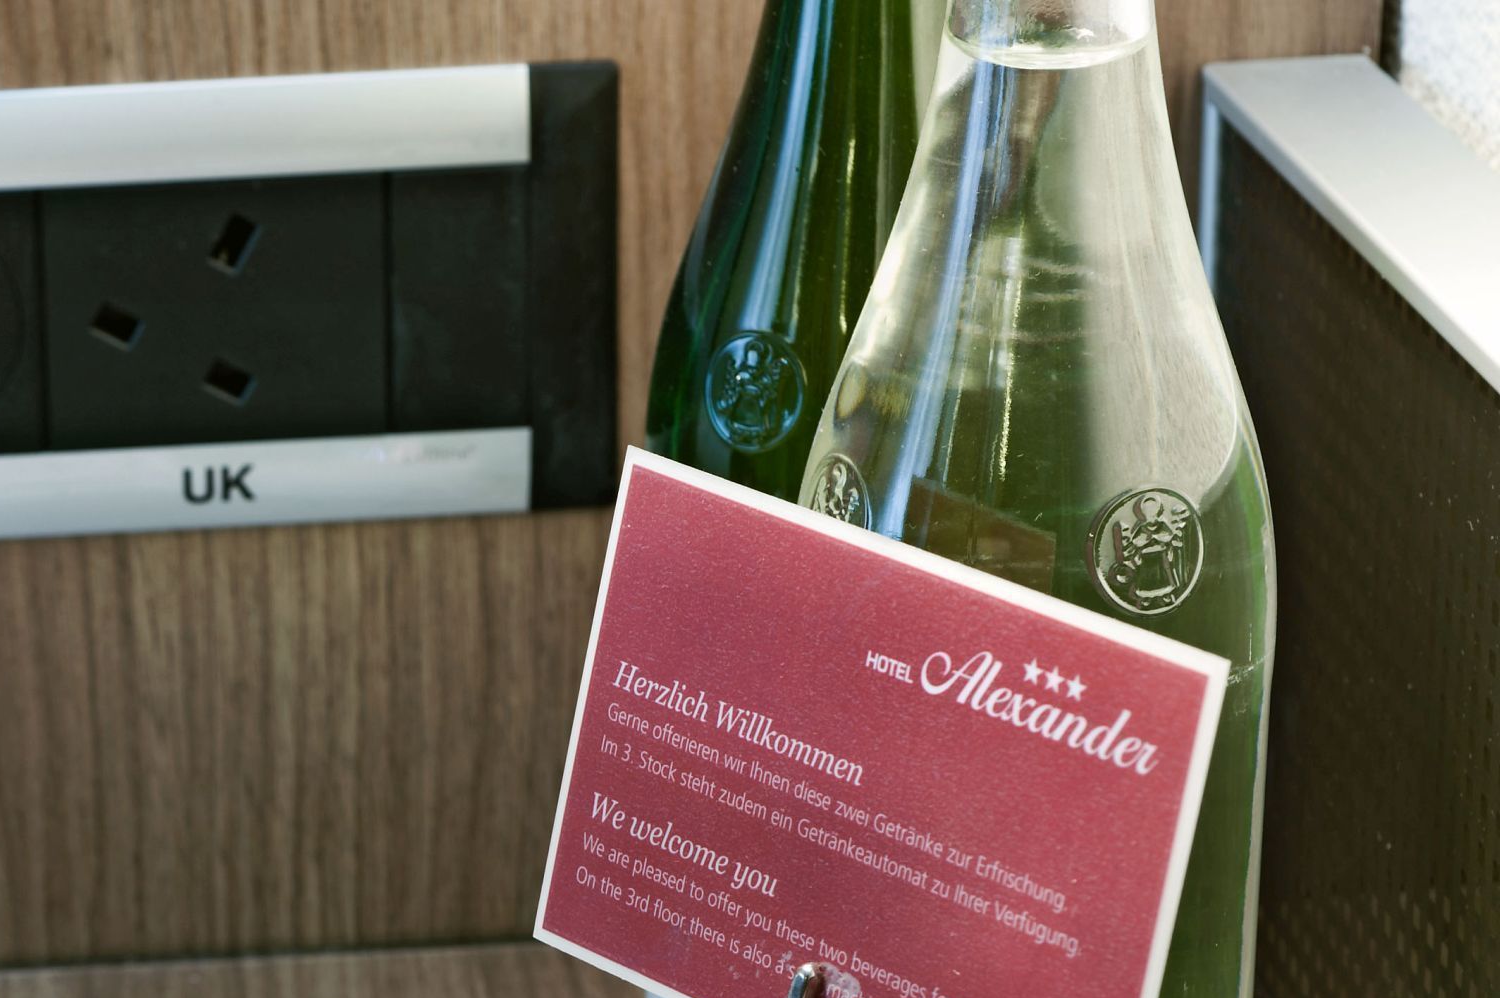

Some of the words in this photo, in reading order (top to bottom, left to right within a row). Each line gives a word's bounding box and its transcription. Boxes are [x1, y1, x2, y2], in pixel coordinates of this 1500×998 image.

[182, 464, 255, 506] UK
[611, 660, 709, 723] Herzlich
[715, 699, 864, 787] Willkommen
[864, 649, 914, 685] HOTEL
[919, 650, 1159, 777] Alexander
[591, 791, 626, 831] We
[629, 816, 730, 876] welcome
[729, 861, 778, 898] you
[600, 733, 619, 758] Im
[620, 742, 634, 764] 3.
[638, 750, 678, 783] Stock
[679, 771, 717, 799] steht
[717, 788, 767, 821] zudem
[770, 810, 793, 832] ein
[797, 817, 929, 890] Getränkeautomat
[930, 878, 951, 899] zu
[953, 884, 991, 915] Ihrer
[994, 900, 1081, 959] Verfügung.
[607, 702, 650, 736] Gerne
[652, 722, 720, 766] offerieren
[723, 753, 748, 775] wir
[749, 760, 791, 794] Ihnen
[793, 780, 832, 811] diese
[834, 800, 871, 827] zwei
[873, 812, 944, 859] Getränke
[945, 847, 973, 870] zur
[975, 854, 1067, 914] Erfrischung.
[575, 865, 597, 890] On
[600, 876, 623, 901] the
[625, 887, 651, 913] 3rd
[653, 898, 687, 929] floor
[689, 916, 726, 948] there
[728, 937, 741, 955] is
[742, 943, 772, 969] also
[774, 952, 787, 975] a
[583, 831, 606, 858] We
[607, 848, 630, 869] are
[631, 856, 687, 894] pleased
[689, 880, 705, 902] to
[707, 890, 743, 918] offer
[743, 908, 772, 933] you
[775, 919, 816, 952] these
[818, 938, 848, 965] two
